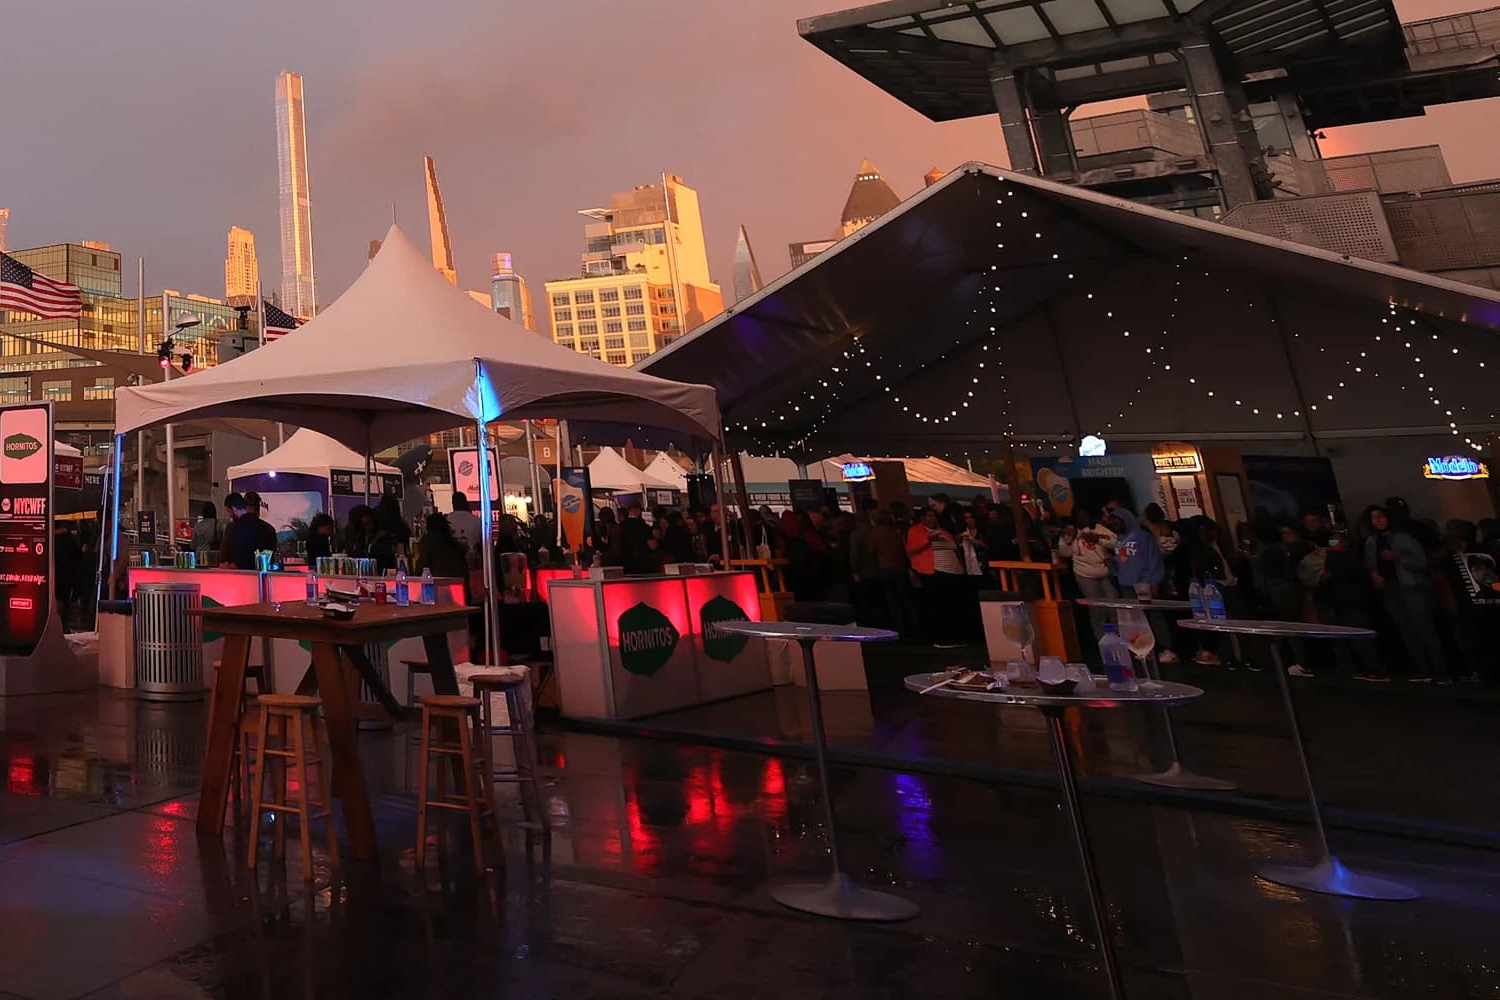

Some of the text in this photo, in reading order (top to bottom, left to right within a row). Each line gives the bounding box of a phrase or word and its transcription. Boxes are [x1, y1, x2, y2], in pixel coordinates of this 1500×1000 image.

[5, 441, 38, 451] HORNITOS
[543, 447, 551, 458] B
[1428, 457, 1478, 474] Modelo
[13, 497, 47, 515] NYCWFF
[622, 626, 674, 652] HORNITOS
